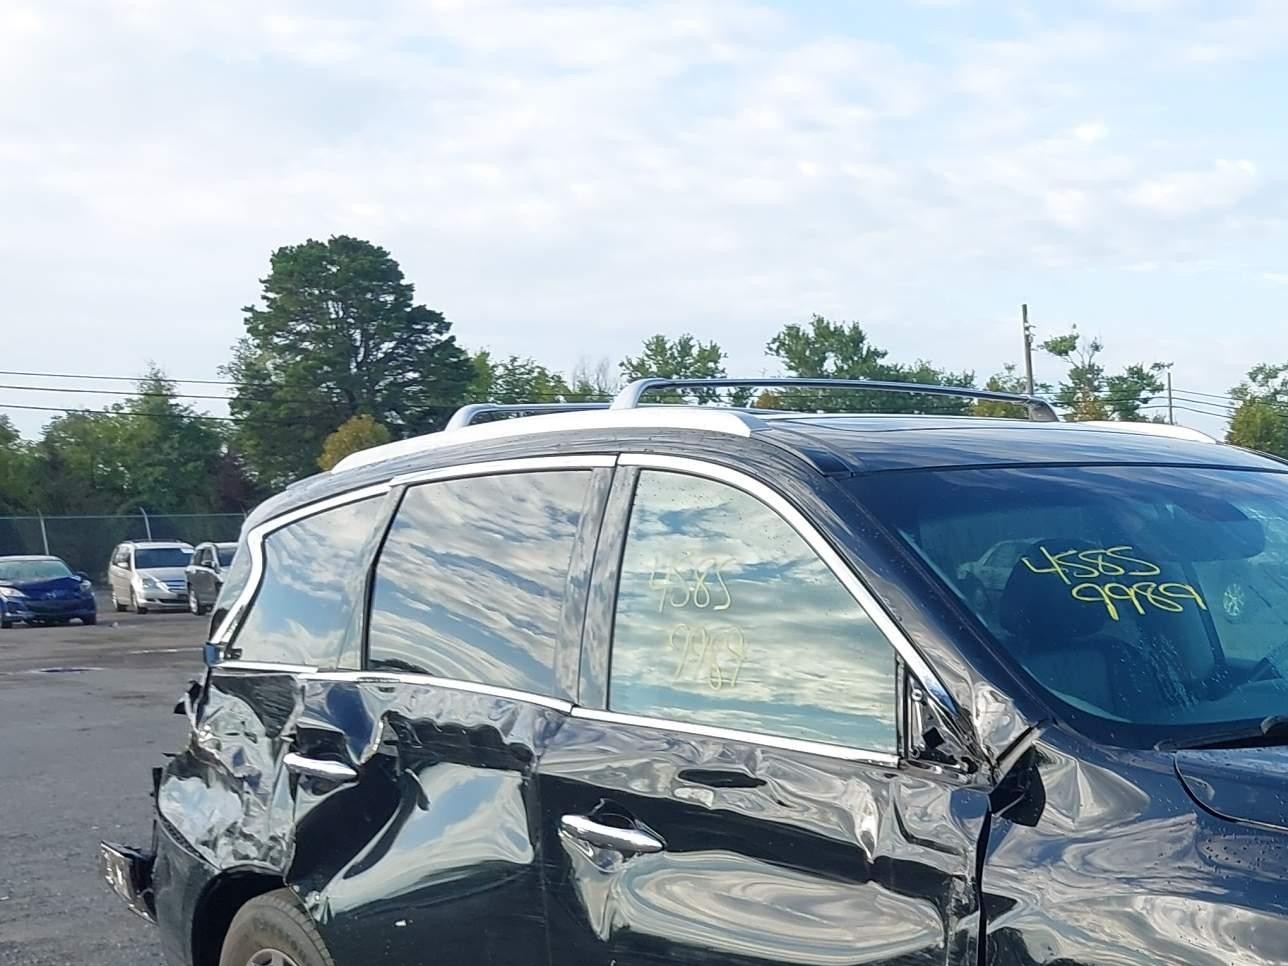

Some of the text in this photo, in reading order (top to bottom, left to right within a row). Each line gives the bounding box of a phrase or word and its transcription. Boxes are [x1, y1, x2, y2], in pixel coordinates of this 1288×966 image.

[1021, 545, 1161, 585] 4585
[644, 557, 737, 615] 4585
[1071, 581, 1208, 622] 9989
